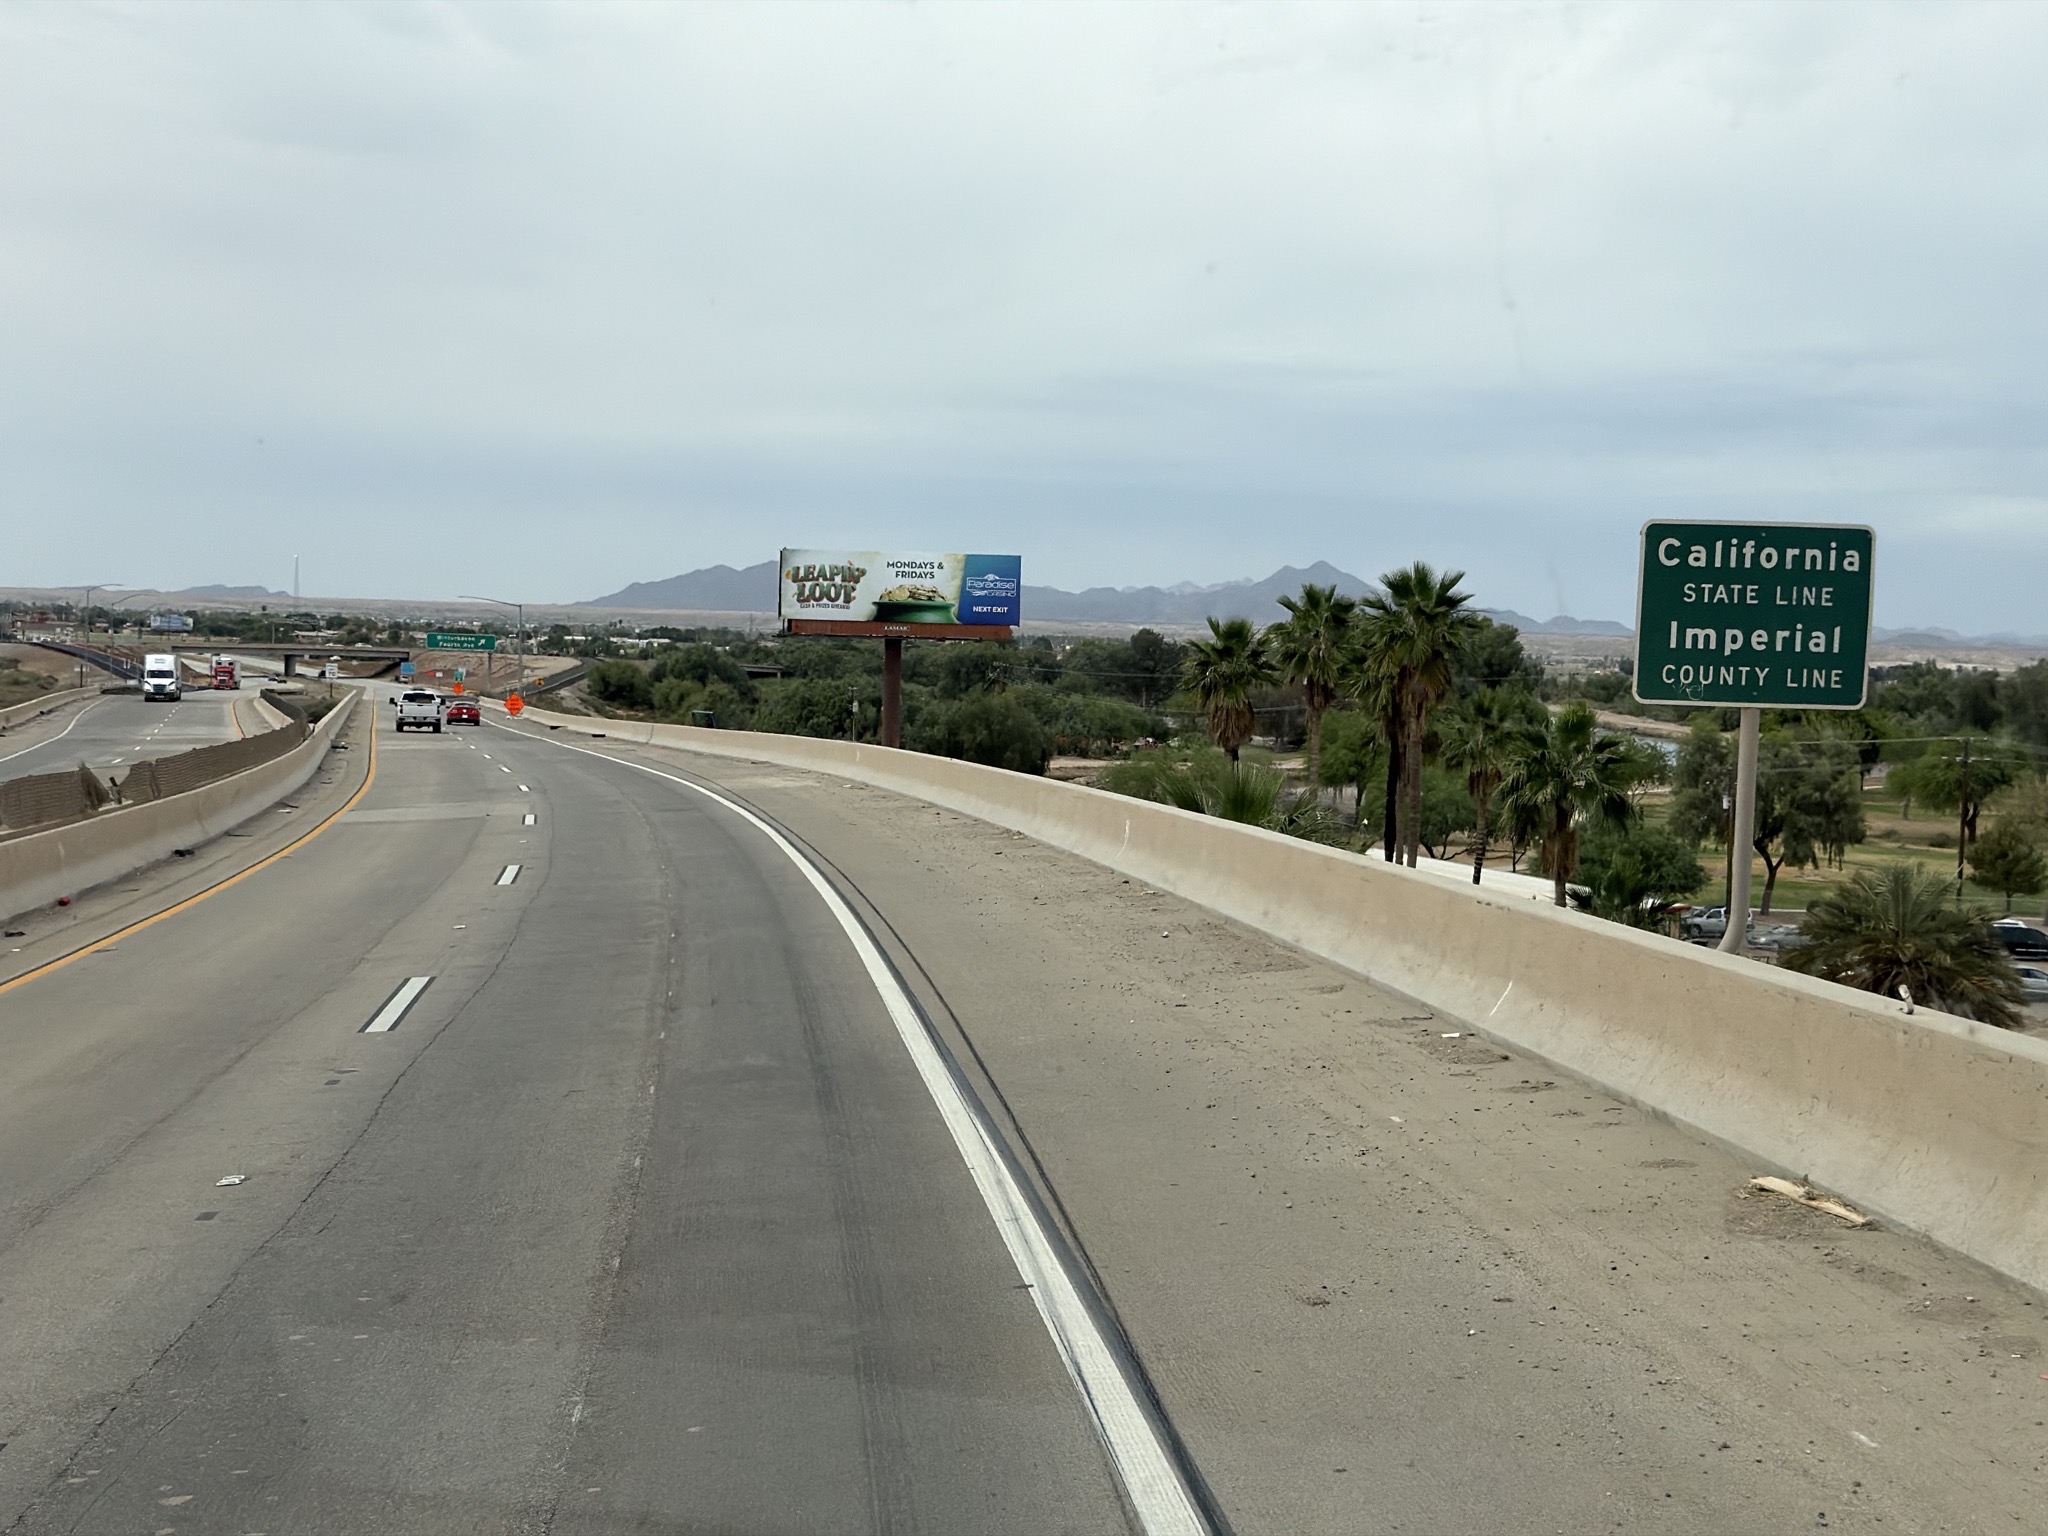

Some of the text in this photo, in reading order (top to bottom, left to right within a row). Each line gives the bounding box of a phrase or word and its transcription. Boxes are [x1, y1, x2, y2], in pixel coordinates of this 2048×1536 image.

[887, 561, 945, 570] MONDAYS &
[1658, 537, 1861, 573] California
[895, 571, 935, 579] FRIDAYS
[968, 580, 1015, 590] Paradise
[796, 582, 857, 603] LOOT
[1683, 583, 1835, 607] STATE LINE
[1669, 620, 1841, 657] Imperial
[1662, 664, 1844, 689] COUNTY LINE
